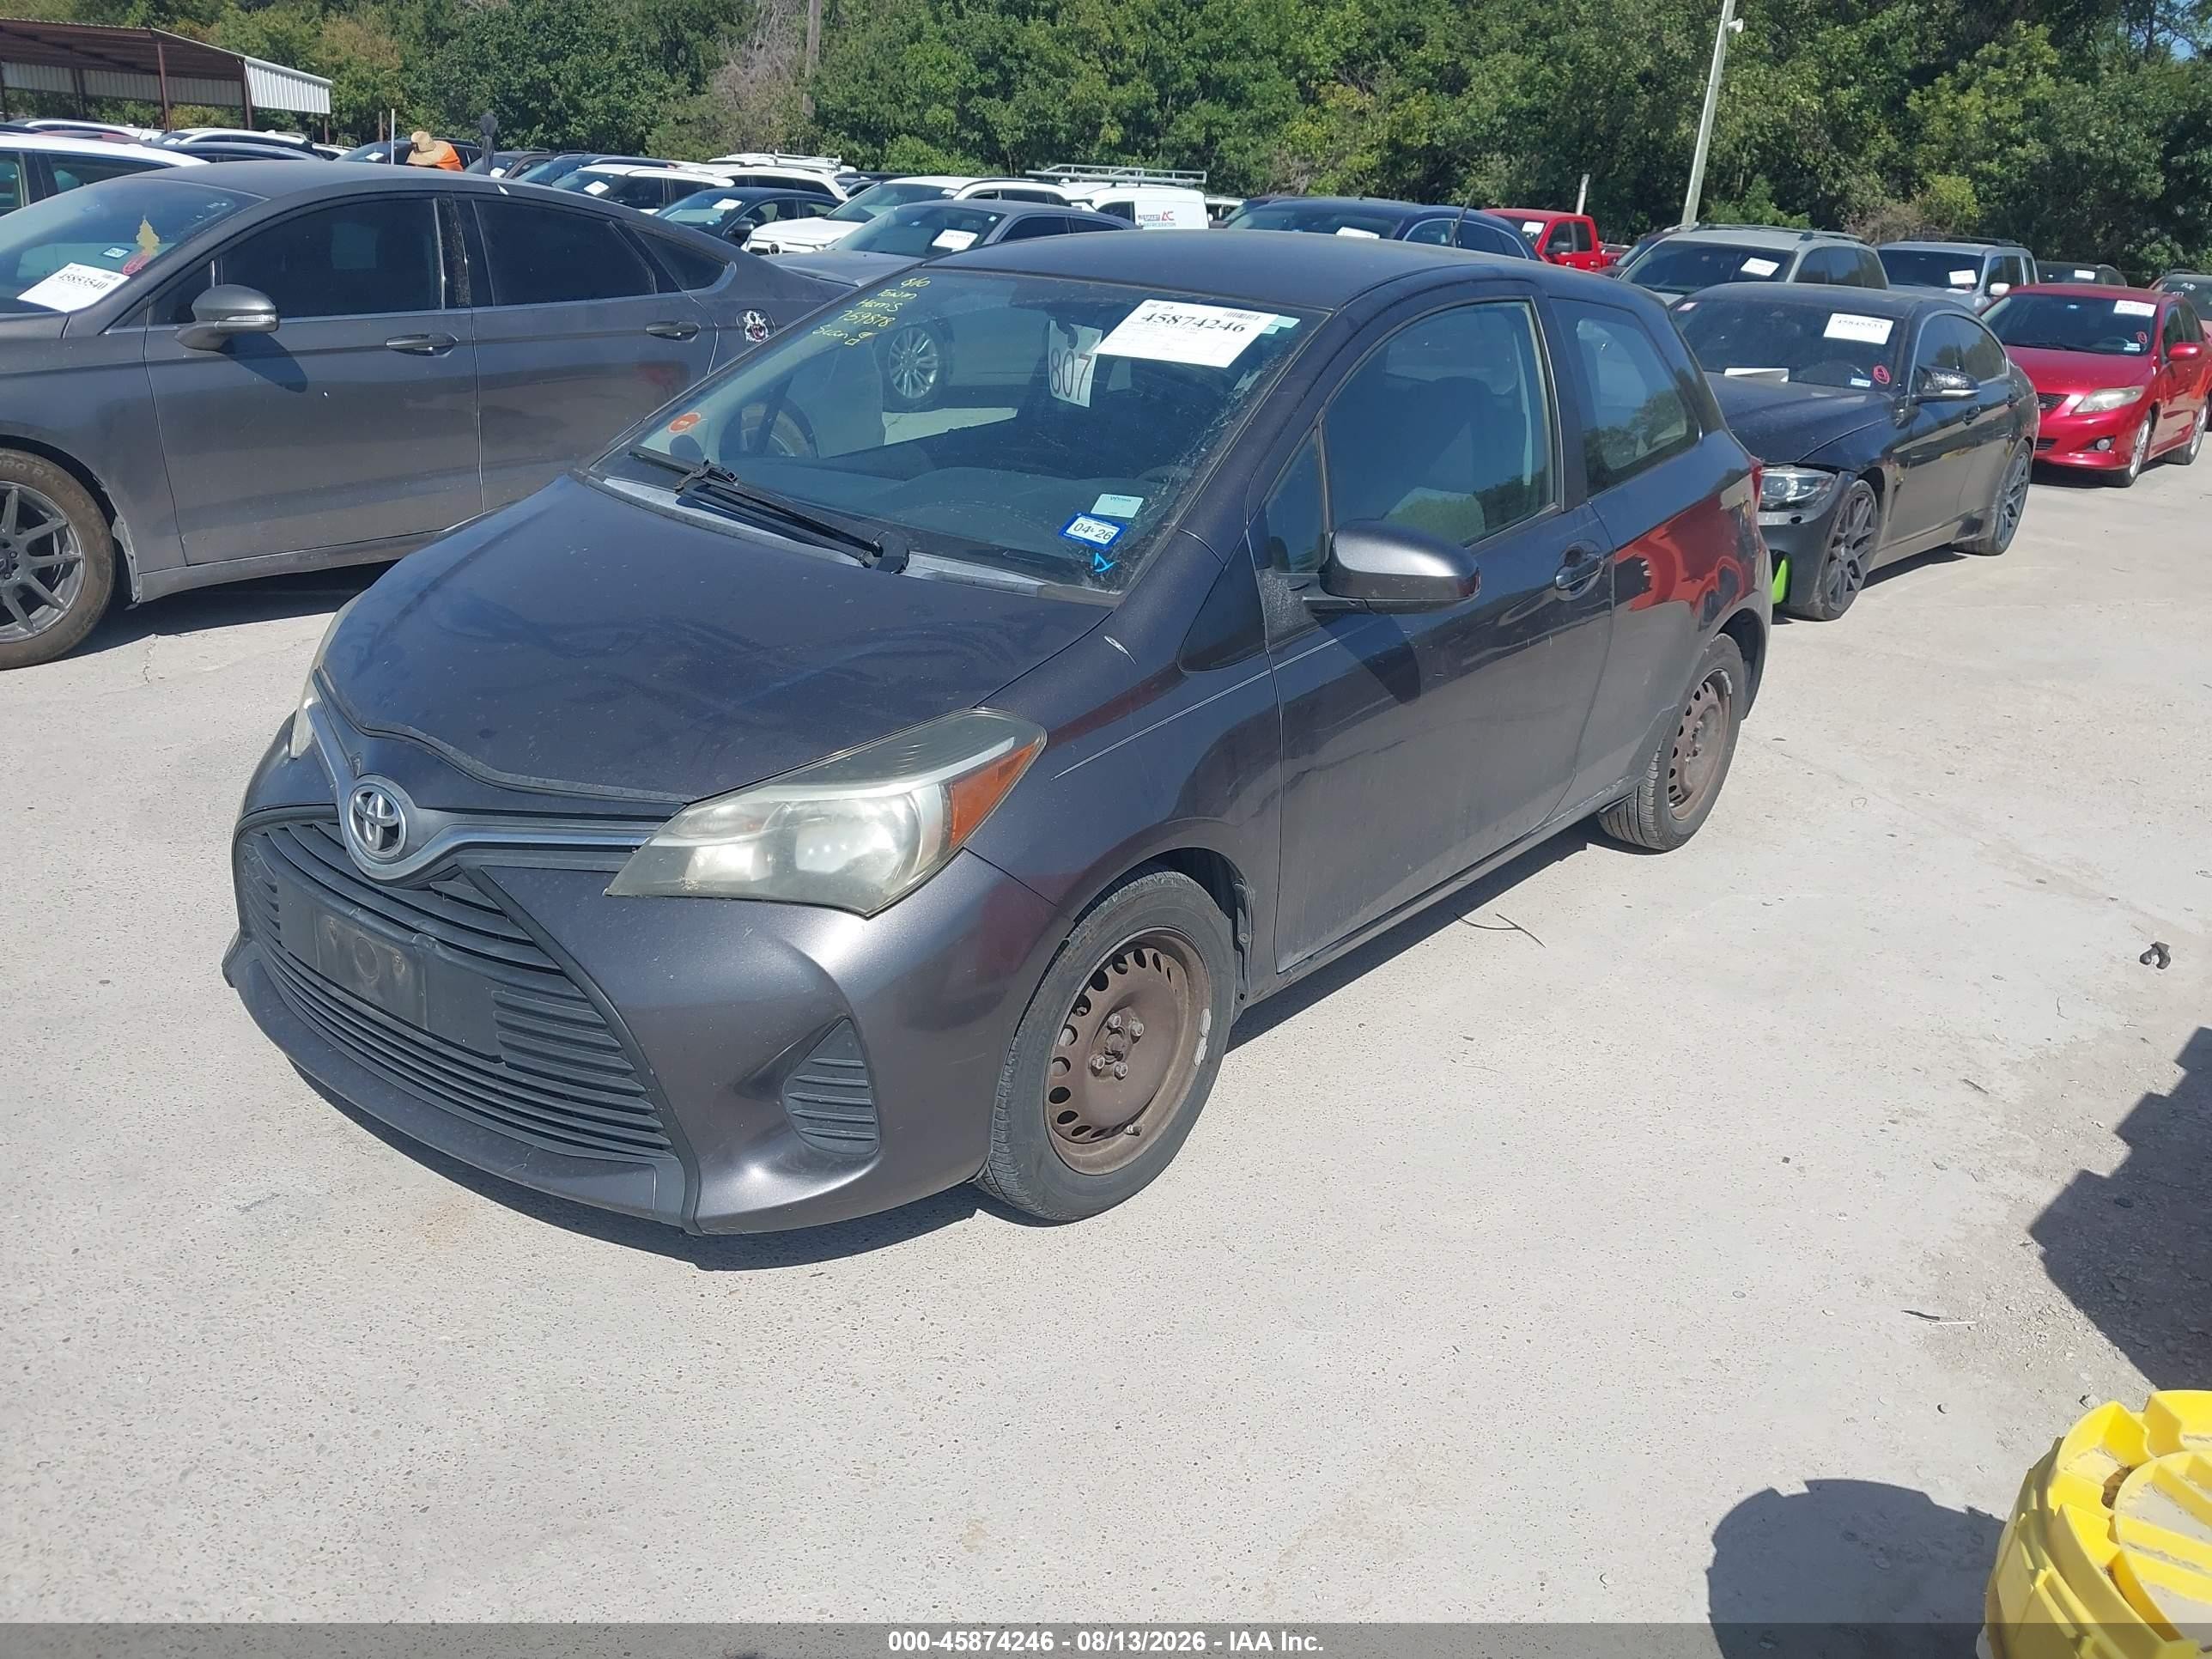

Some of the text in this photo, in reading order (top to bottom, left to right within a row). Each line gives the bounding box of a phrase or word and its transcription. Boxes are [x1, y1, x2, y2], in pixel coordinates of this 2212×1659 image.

[837, 310, 896, 327] 759878
[1141, 313, 1249, 332] 45874246
[1051, 348, 1093, 401] 807
